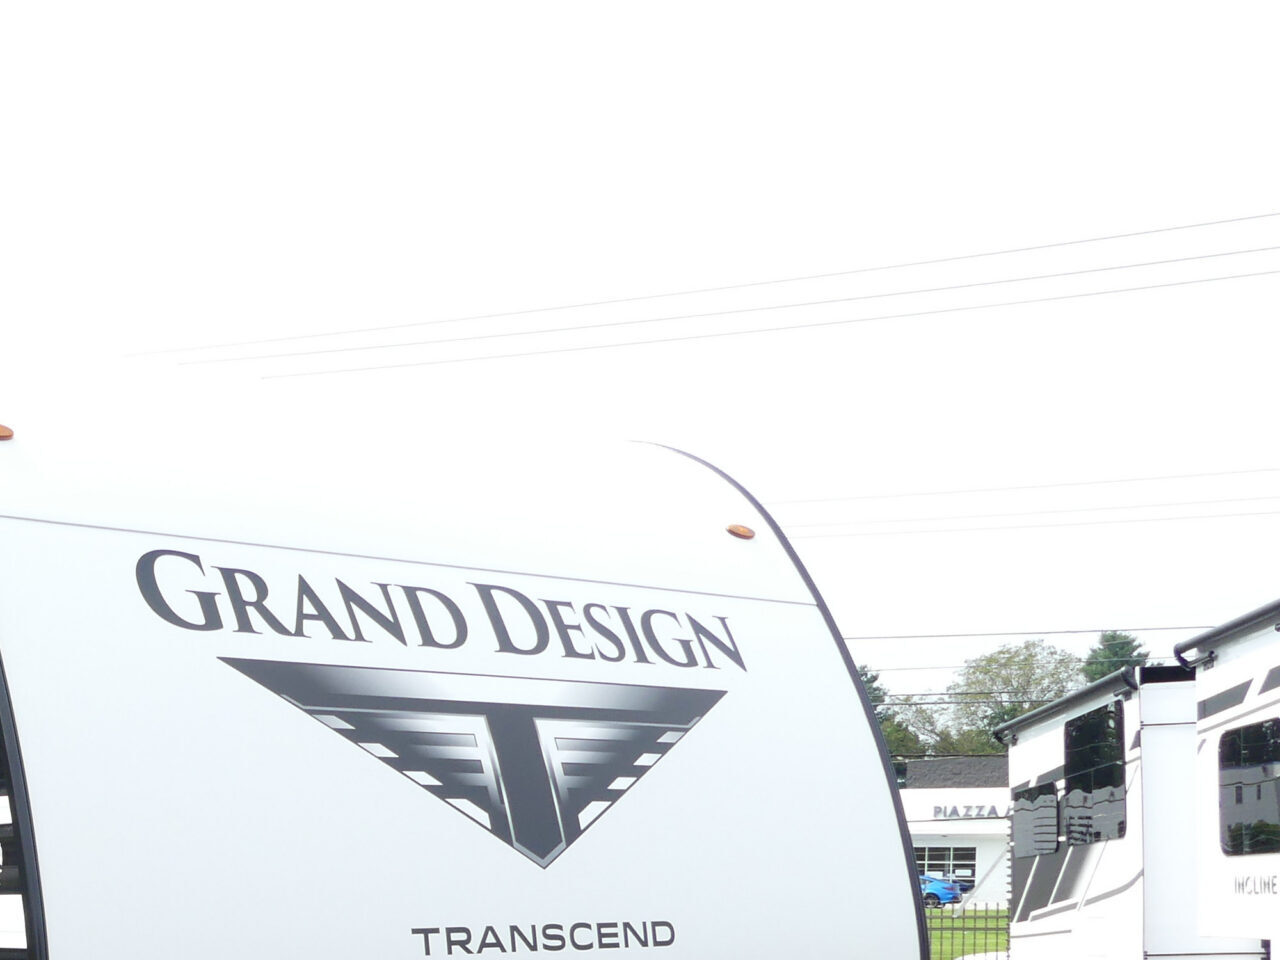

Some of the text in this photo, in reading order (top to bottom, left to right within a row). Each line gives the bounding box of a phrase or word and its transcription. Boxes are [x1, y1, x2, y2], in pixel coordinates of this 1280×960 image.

[135, 548, 748, 673] GRAND DESIGN
[933, 805, 1000, 818] PIAZZA
[411, 920, 675, 956] TRANSCEND
